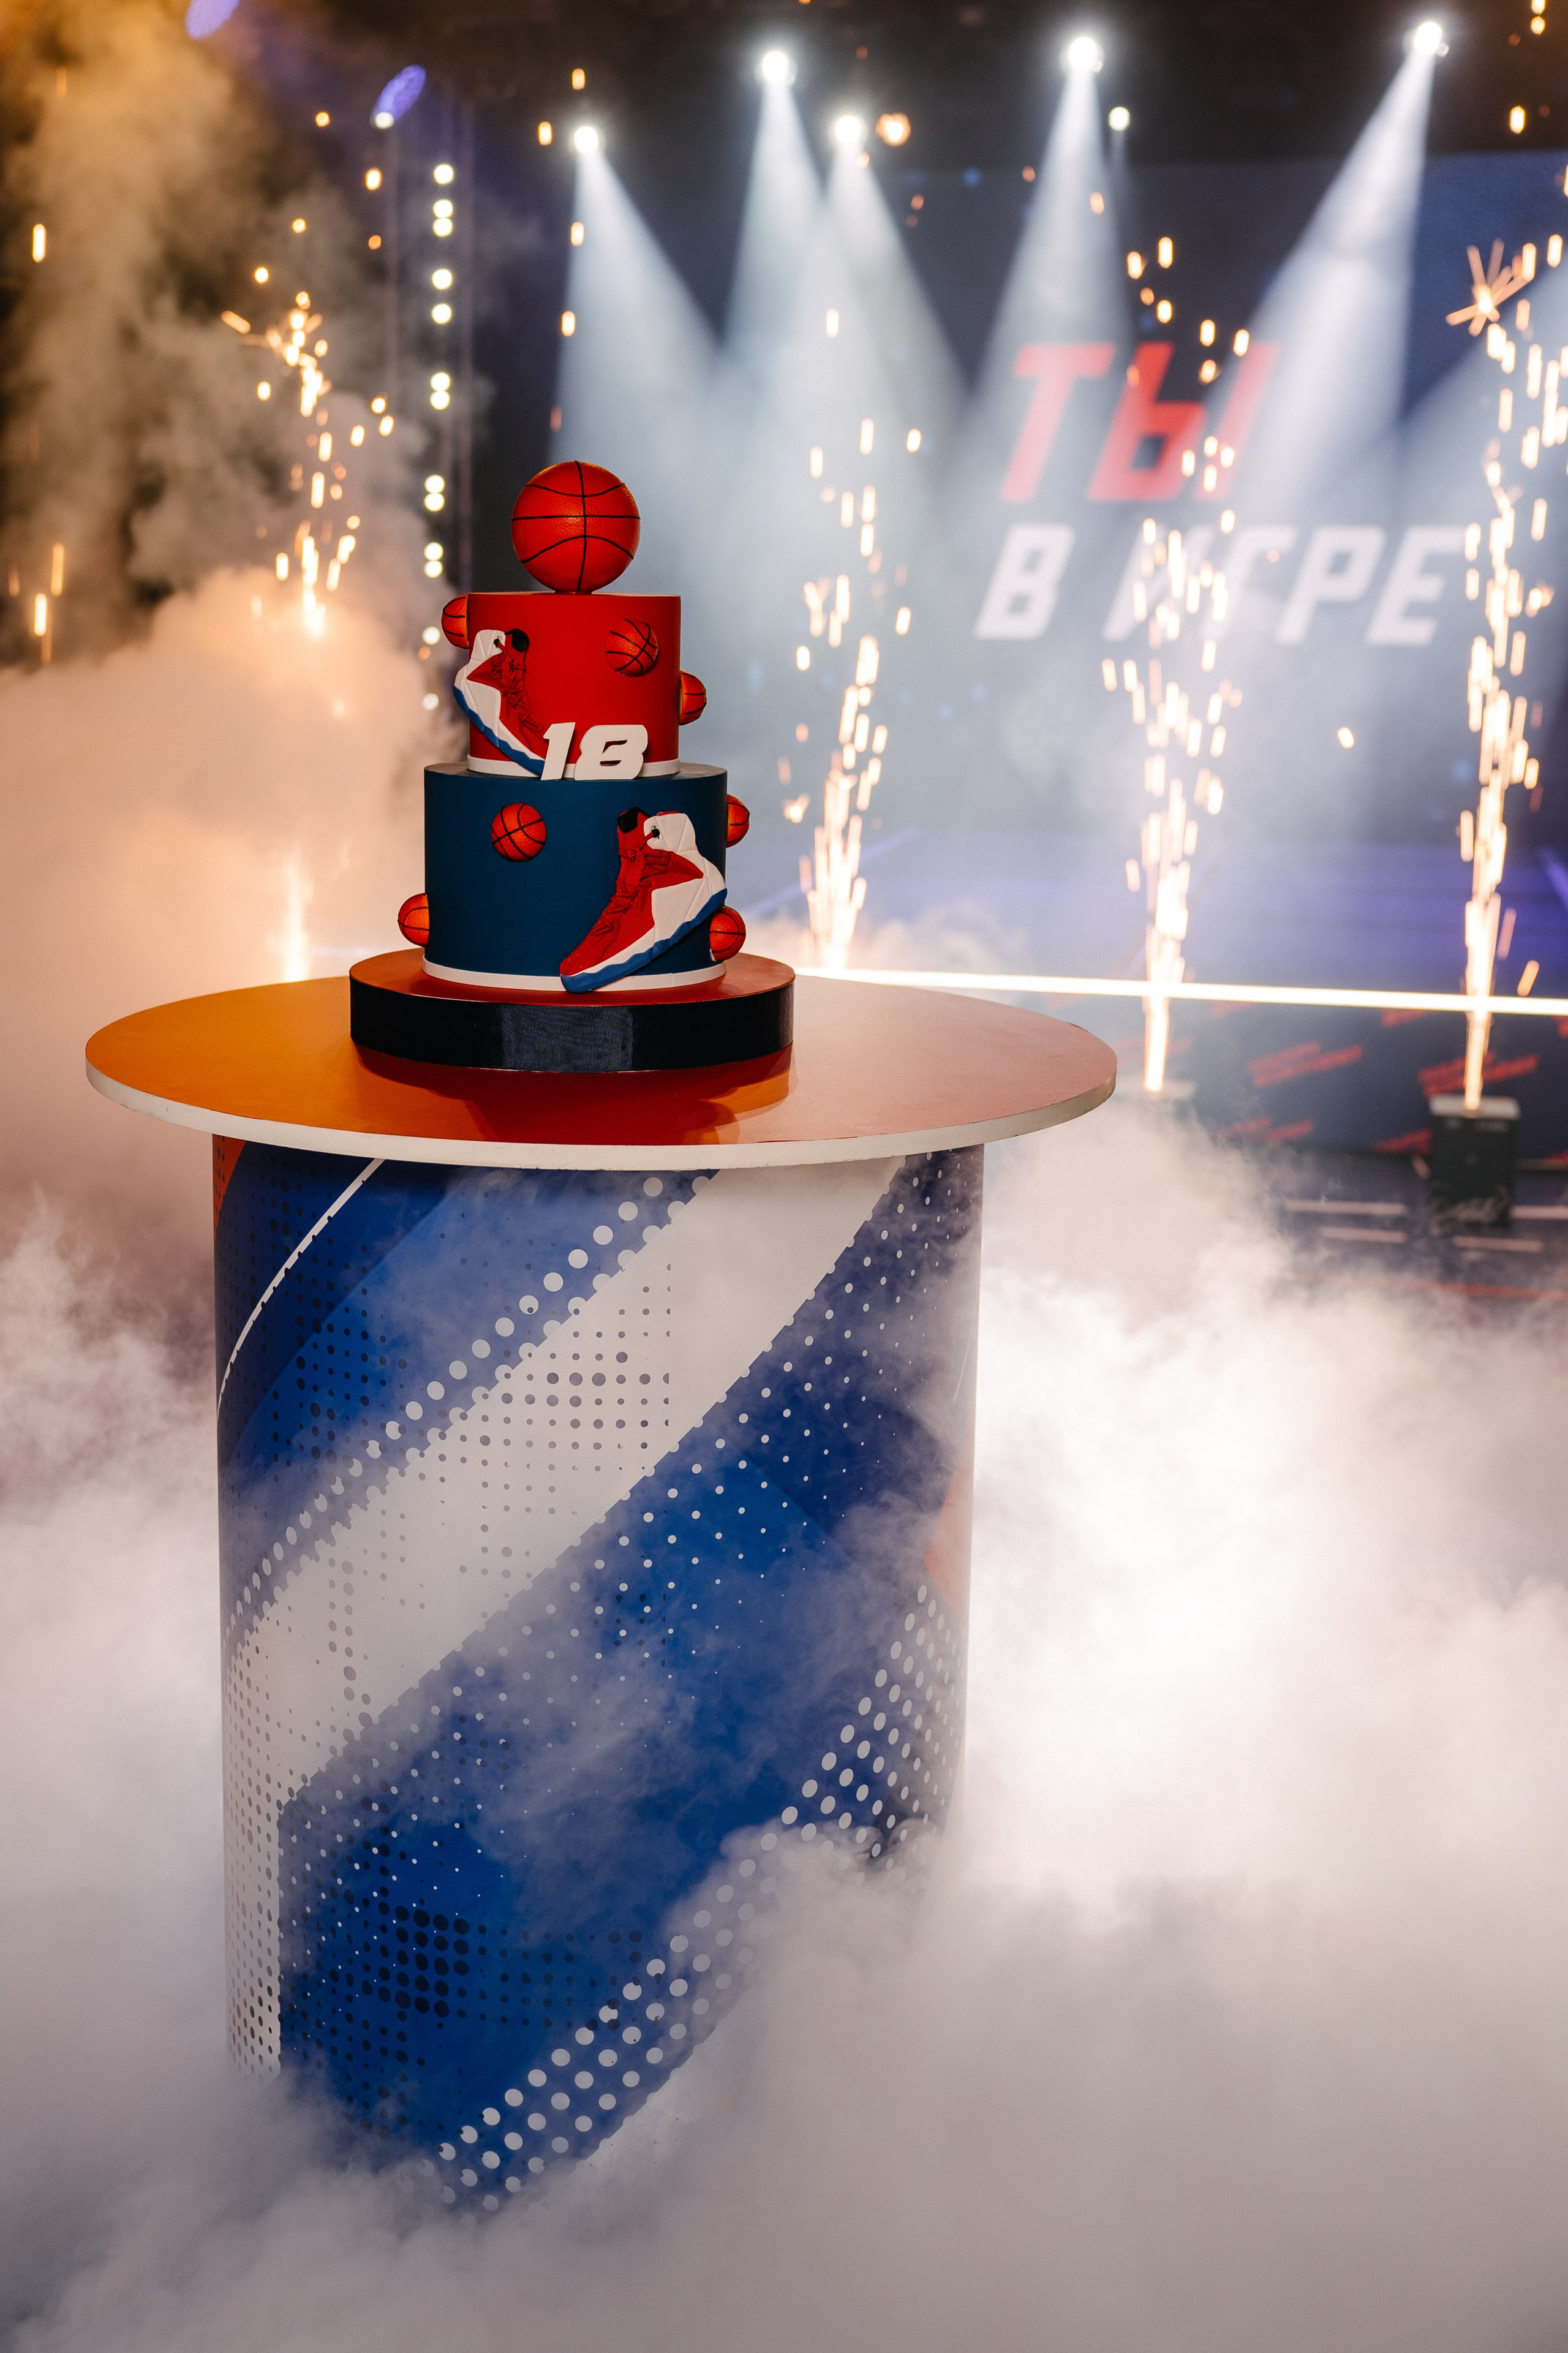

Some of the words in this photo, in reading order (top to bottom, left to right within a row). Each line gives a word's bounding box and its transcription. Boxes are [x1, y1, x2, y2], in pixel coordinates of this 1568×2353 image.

[999, 341, 1283, 503] ТЫ
[973, 524, 1076, 641] В
[540, 722, 649, 781] 18
